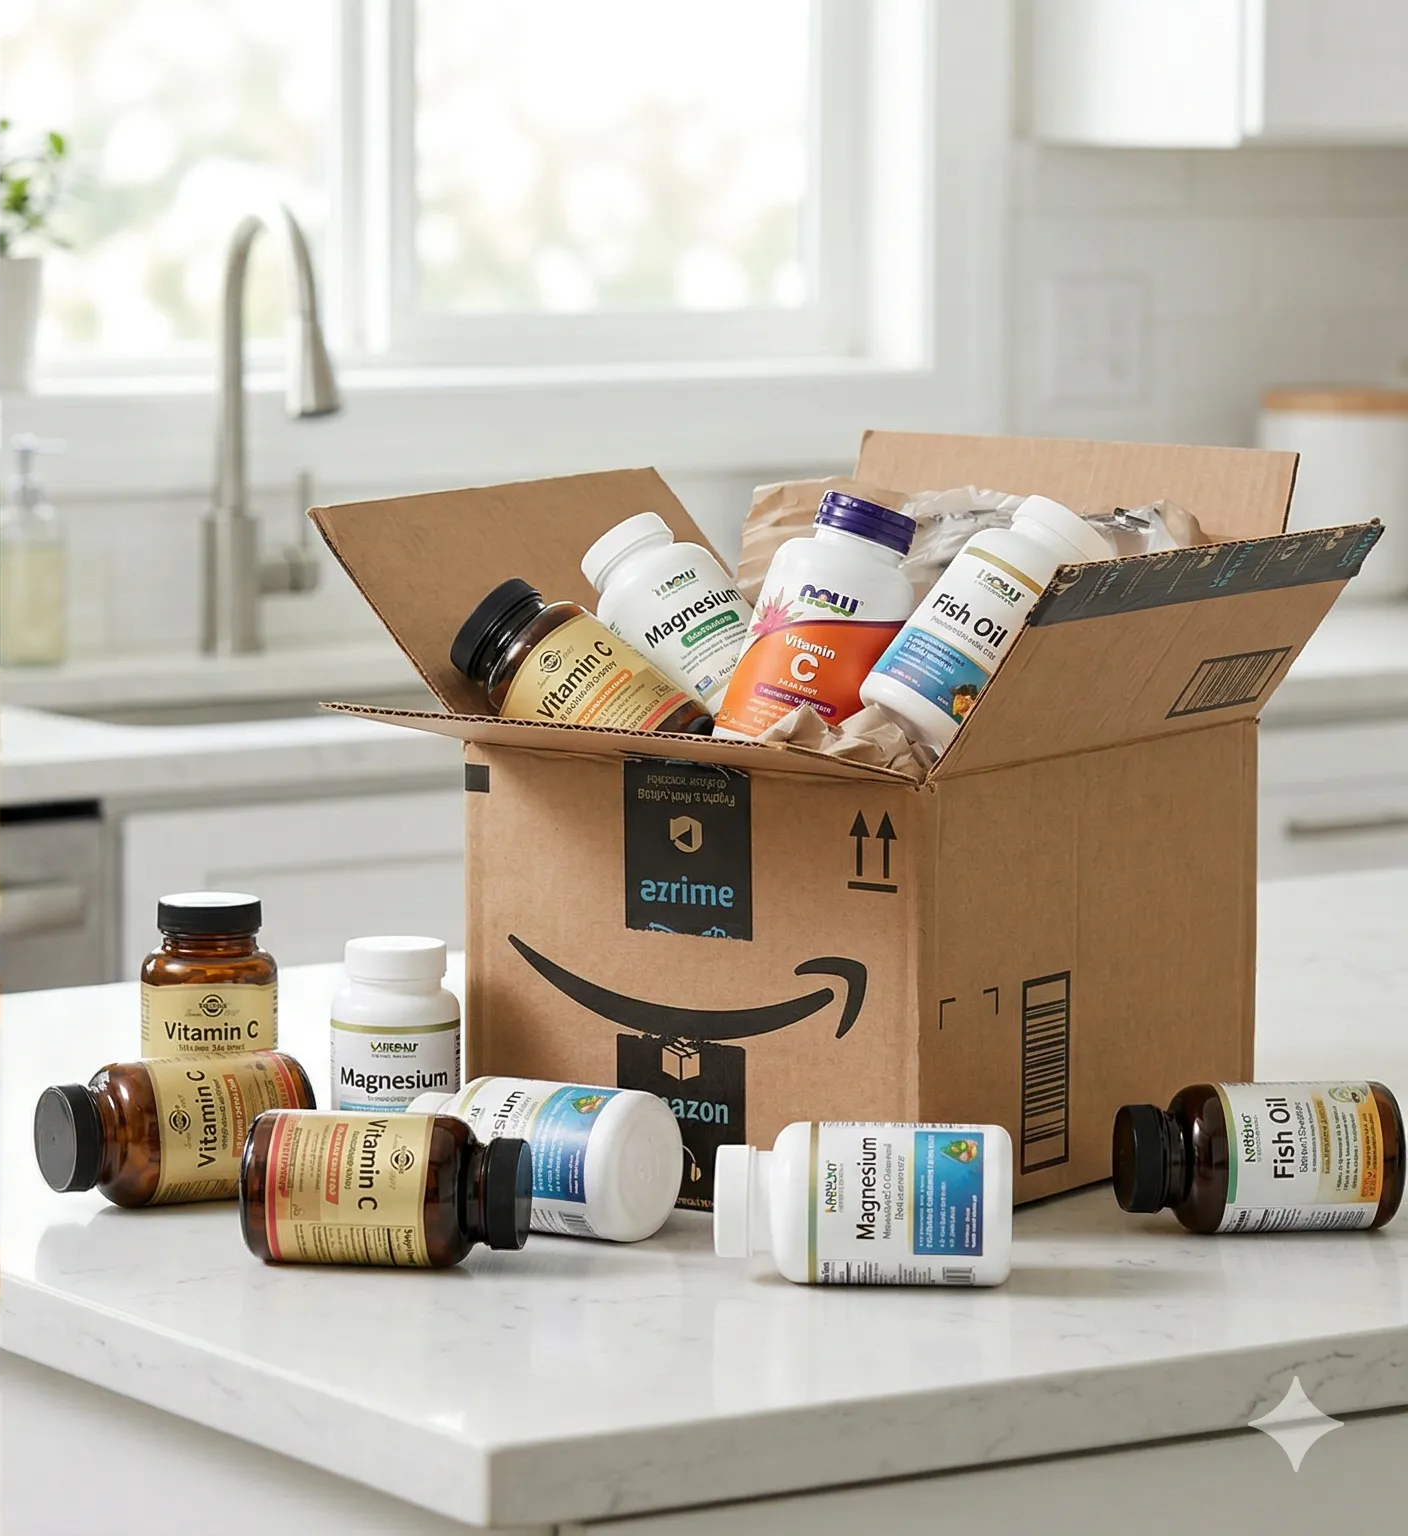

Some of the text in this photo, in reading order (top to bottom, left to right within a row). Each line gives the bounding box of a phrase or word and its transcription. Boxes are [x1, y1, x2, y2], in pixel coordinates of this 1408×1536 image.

[644, 589, 742, 649] Magnesium
[784, 632, 836, 661] Vitamin
[932, 592, 972, 626] Fish
[973, 617, 1009, 648] Oil
[536, 654, 601, 720] Vitamin
[593, 640, 613, 657] C
[789, 652, 819, 683] C
[164, 1020, 259, 1042] Vitamin C
[340, 1066, 448, 1094] Magnesium
[186, 1070, 218, 1169] Vitamin C
[1264, 1097, 1295, 1179] Fish Oil
[357, 1119, 389, 1211] Vitamin C
[855, 1136, 881, 1241] Magnesium
